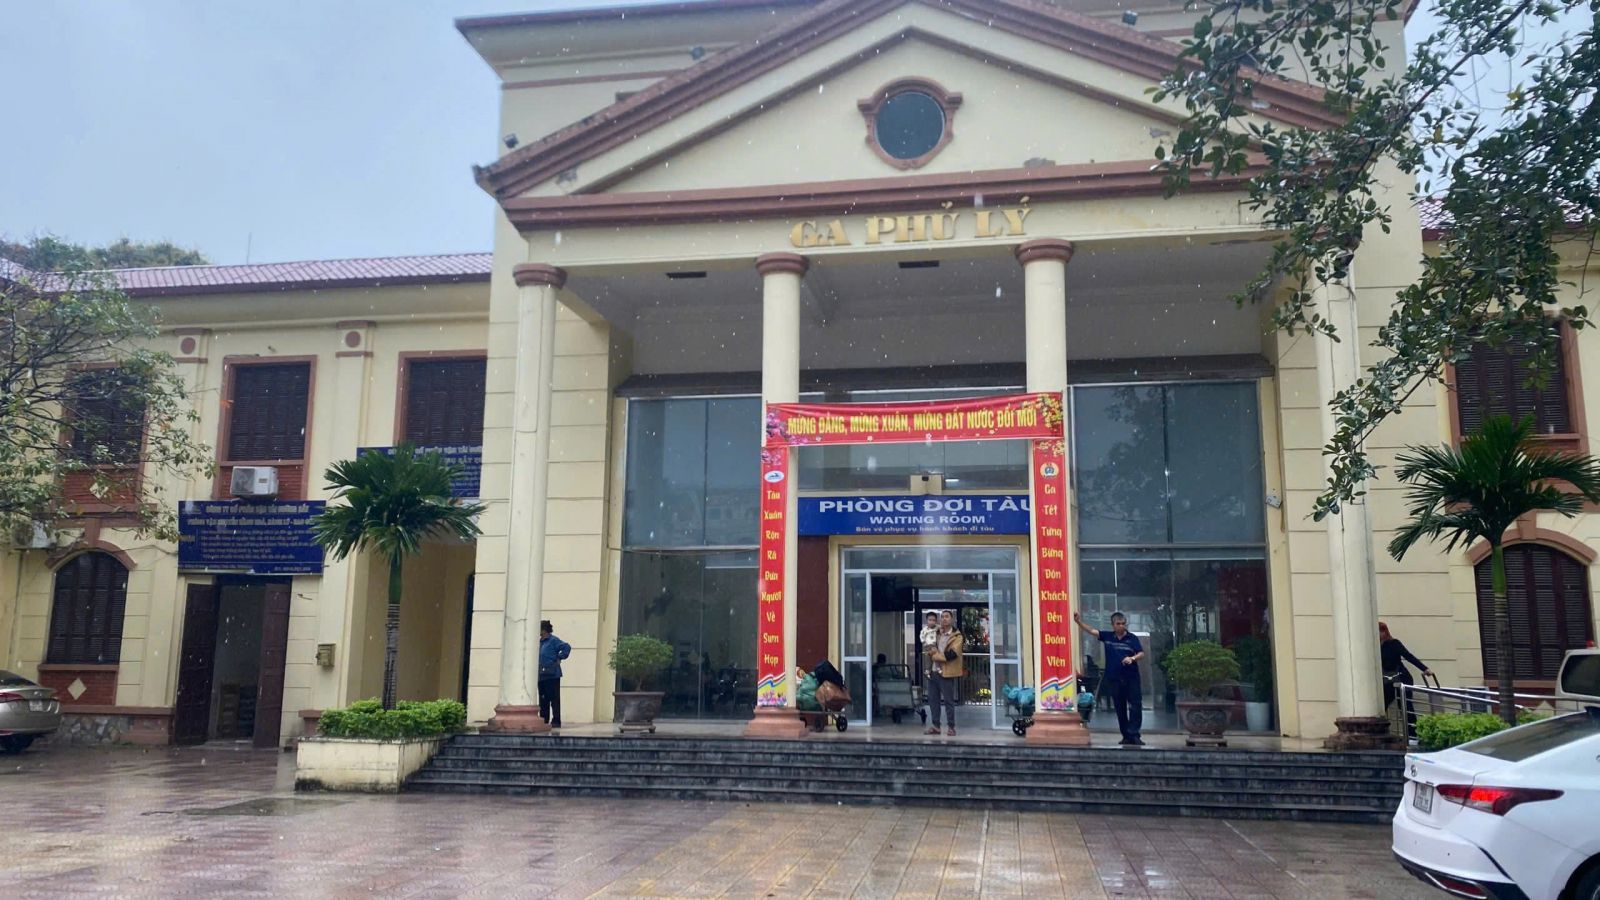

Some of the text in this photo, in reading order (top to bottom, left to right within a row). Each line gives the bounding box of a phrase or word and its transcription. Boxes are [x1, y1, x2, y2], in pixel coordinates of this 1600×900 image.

[790, 195, 1033, 248] GA PHỦ LÝ
[787, 414, 817, 434] MỪNG
[850, 412, 879, 433] MỪNG
[881, 410, 911, 433] XUÂN,
[914, 409, 942, 431] MỪNG
[945, 405, 964, 430] ĐẤT
[967, 407, 995, 429] NƯỚC
[1017, 406, 1037, 427] MỚI
[1044, 484, 1056, 495] Ga
[819, 497, 914, 513] PHÒNG
[922, 498, 972, 515] ĐỢI
[1044, 504, 1058, 516] Tết
[764, 510, 783, 520] Xuân
[869, 515, 986, 525] WAITING ROOM
[885, 526, 905, 534] phục
[1041, 526, 1062, 539] Tưng
[1041, 547, 1063, 560] Bừng
[1041, 590, 1067, 601] Khách
[763, 632, 779, 644] Sum
